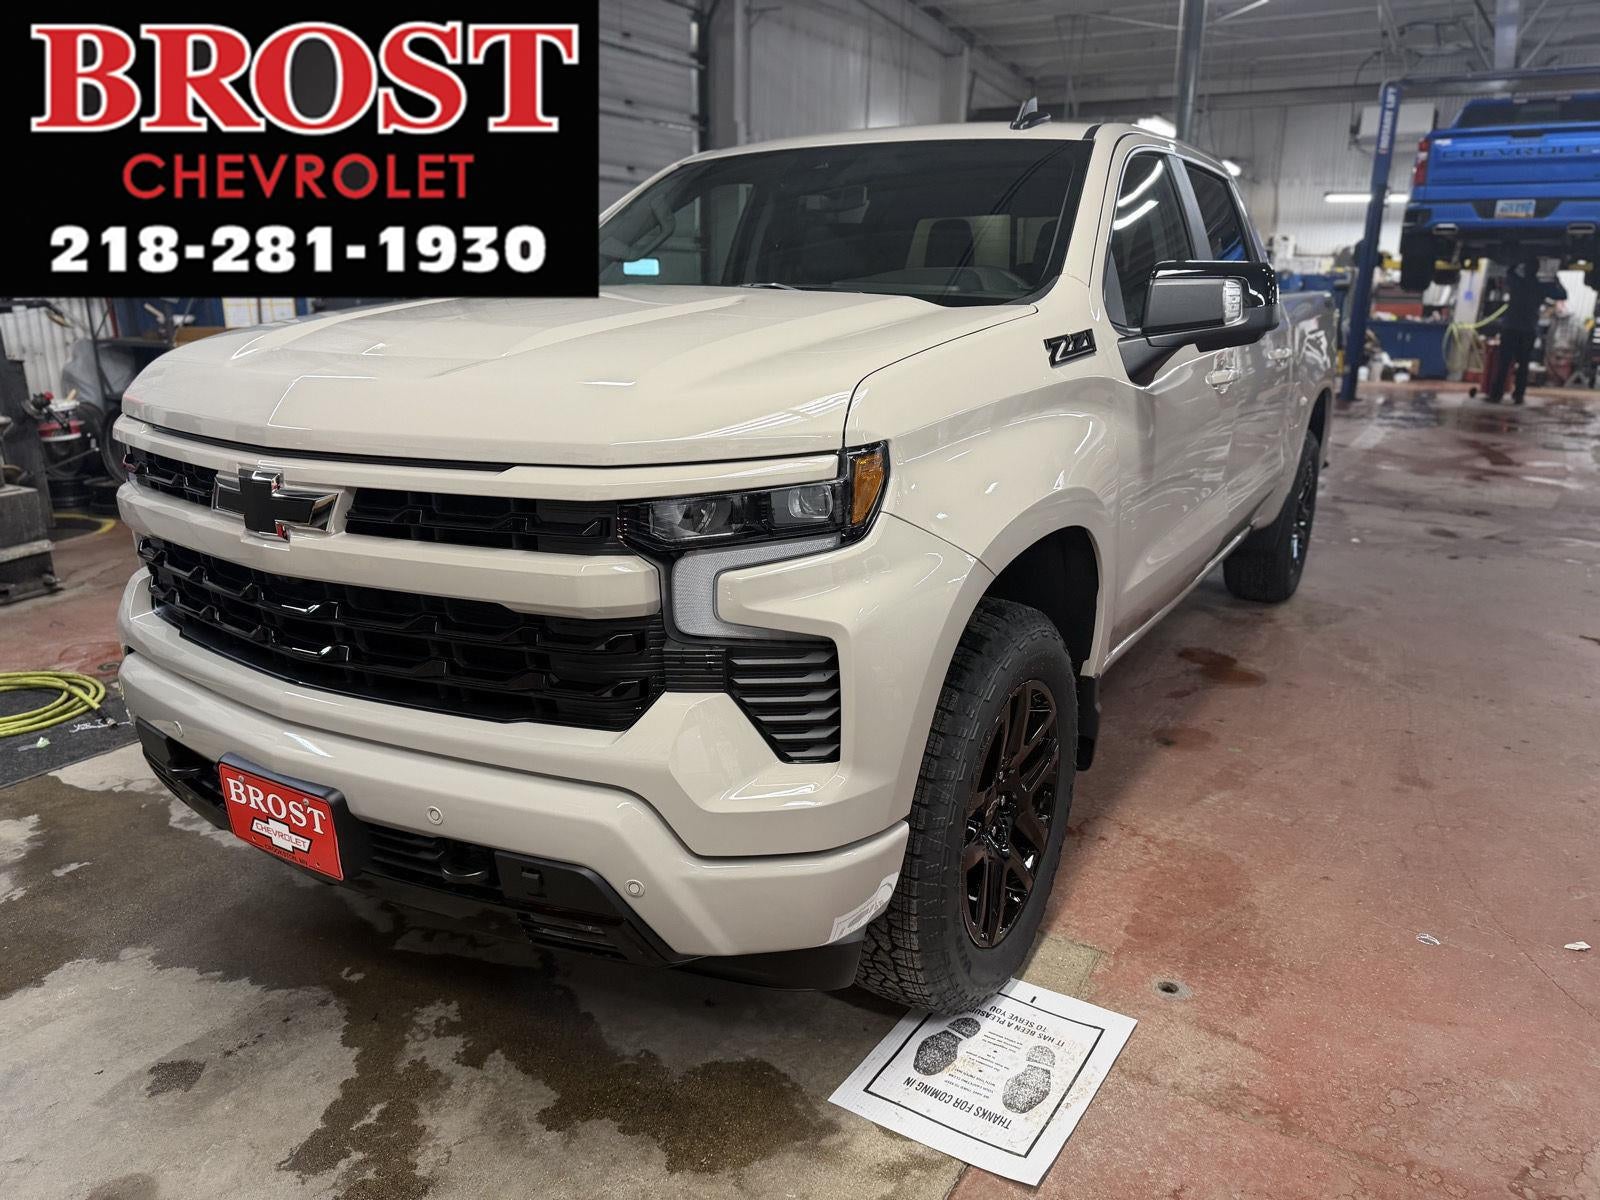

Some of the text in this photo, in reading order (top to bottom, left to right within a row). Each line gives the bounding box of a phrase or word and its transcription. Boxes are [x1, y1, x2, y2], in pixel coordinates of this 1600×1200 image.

[226, 777, 326, 835] BROST
[255, 822, 307, 849] CHEVROLET
[968, 1007, 1006, 1025] PLEASU
[989, 1005, 1047, 1032] TO SERVE YOU
[1013, 1024, 1036, 1036] BEEN
[1037, 1032, 1055, 1043] HAS
[1055, 1039, 1065, 1047] IT
[902, 1076, 917, 1087] IN
[915, 1081, 953, 1103] COMING
[952, 1097, 974, 1113] FOR
[973, 1106, 1011, 1129] THANKS
